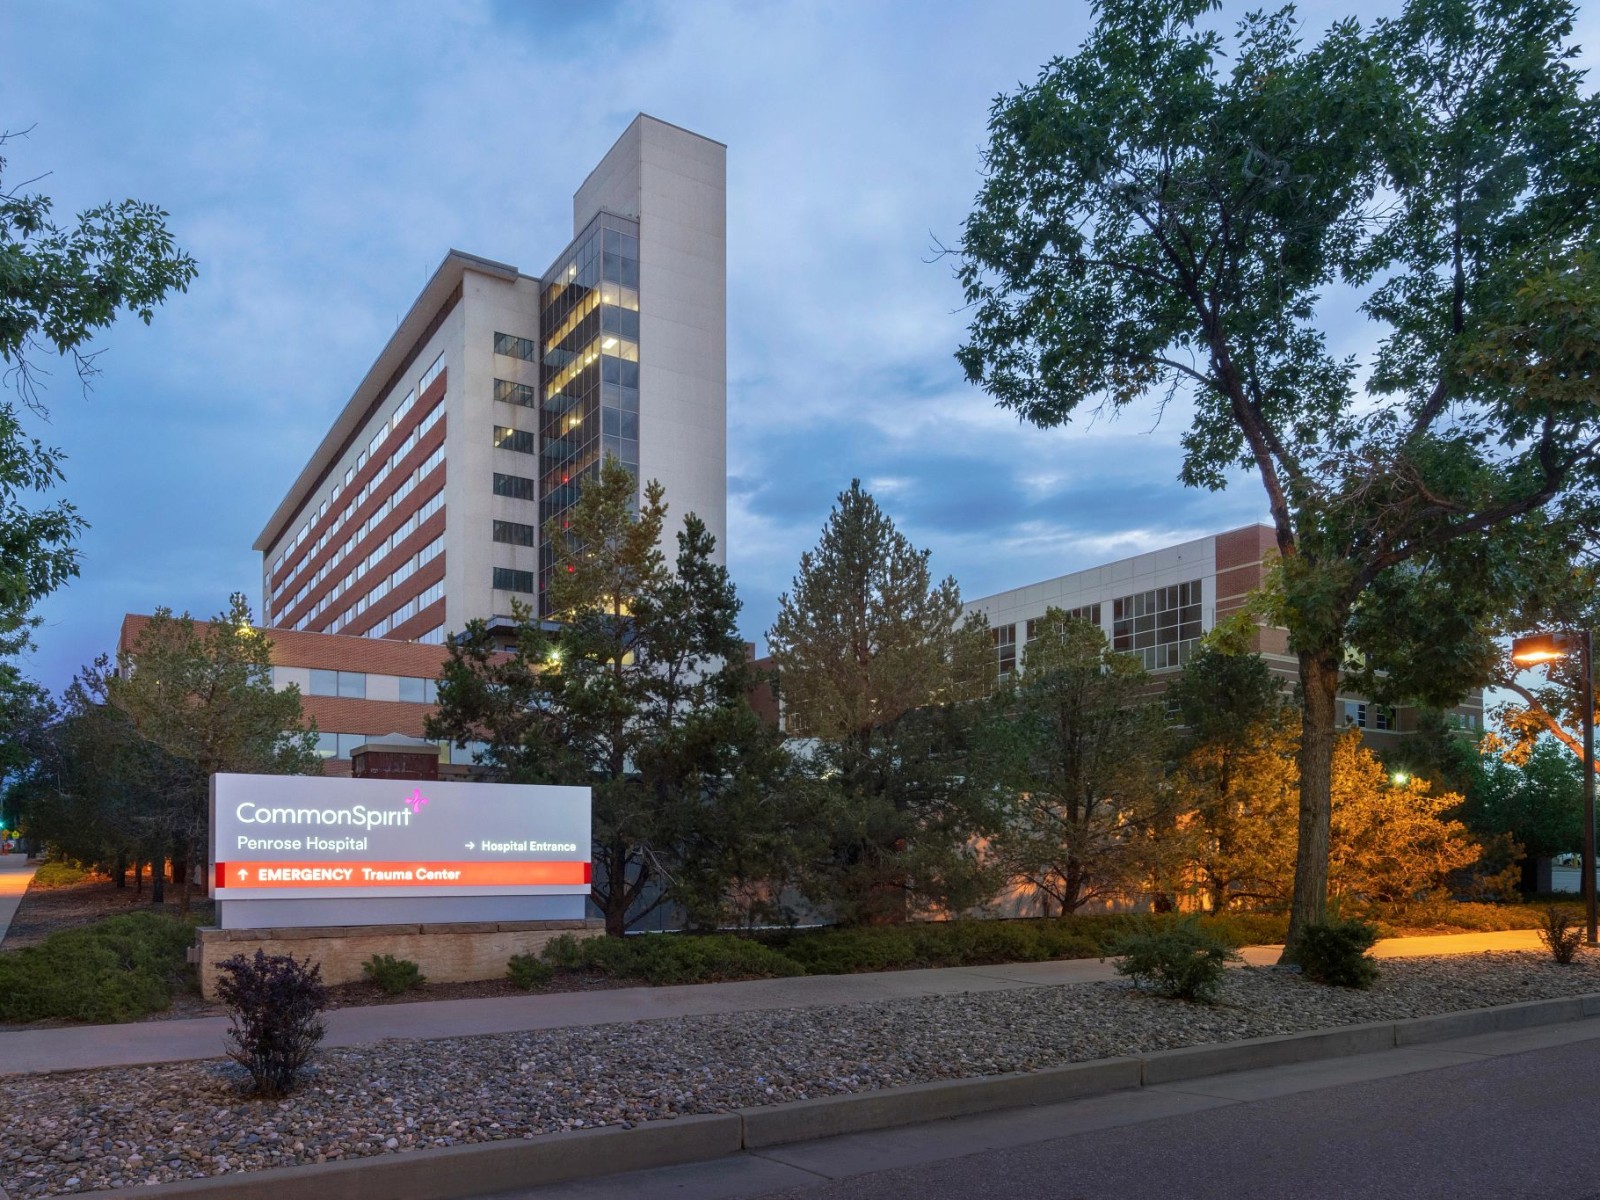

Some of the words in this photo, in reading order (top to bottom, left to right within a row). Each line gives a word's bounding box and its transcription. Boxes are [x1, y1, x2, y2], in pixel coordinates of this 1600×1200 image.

[236, 801, 413, 830] CommonSpirit
[236, 836, 302, 851] Penrose
[306, 835, 368, 853] Hospital
[481, 840, 527, 853] Hospital
[529, 841, 577, 853] Entrance
[258, 868, 352, 882] EMERGENCY
[362, 868, 413, 881] Trauma
[416, 868, 461, 881] Center
